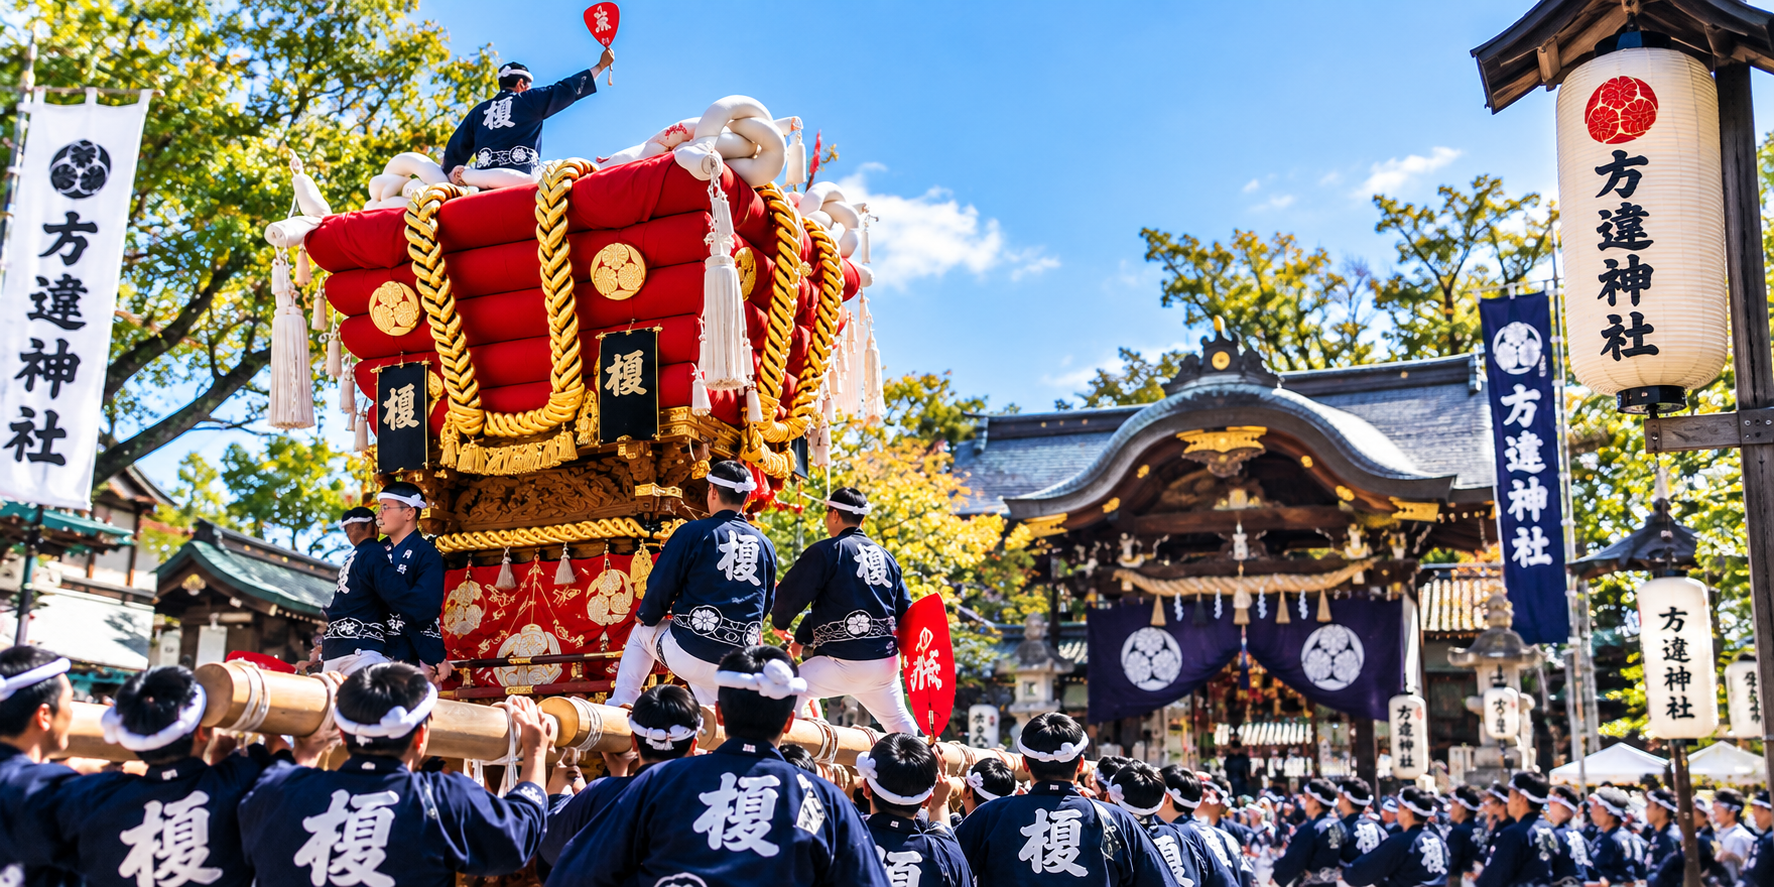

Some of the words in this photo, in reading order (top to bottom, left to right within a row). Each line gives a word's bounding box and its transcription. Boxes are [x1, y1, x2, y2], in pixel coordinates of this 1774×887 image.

[483, 96, 516, 130] 榎
[1594, 149, 1660, 362] 方違神社
[2, 210, 99, 467] 方違神社
[604, 349, 648, 397] 榎
[382, 382, 420, 431] 榎
[1500, 383, 1553, 569] 方違神社
[716, 529, 762, 587] 榎
[853, 542, 893, 588] 榎
[1658, 606, 1696, 720] 方違神社
[118, 790, 224, 887] 榎
[293, 788, 400, 887] 榎
[693, 771, 781, 858] 榎
[1018, 807, 1089, 878] 榎
